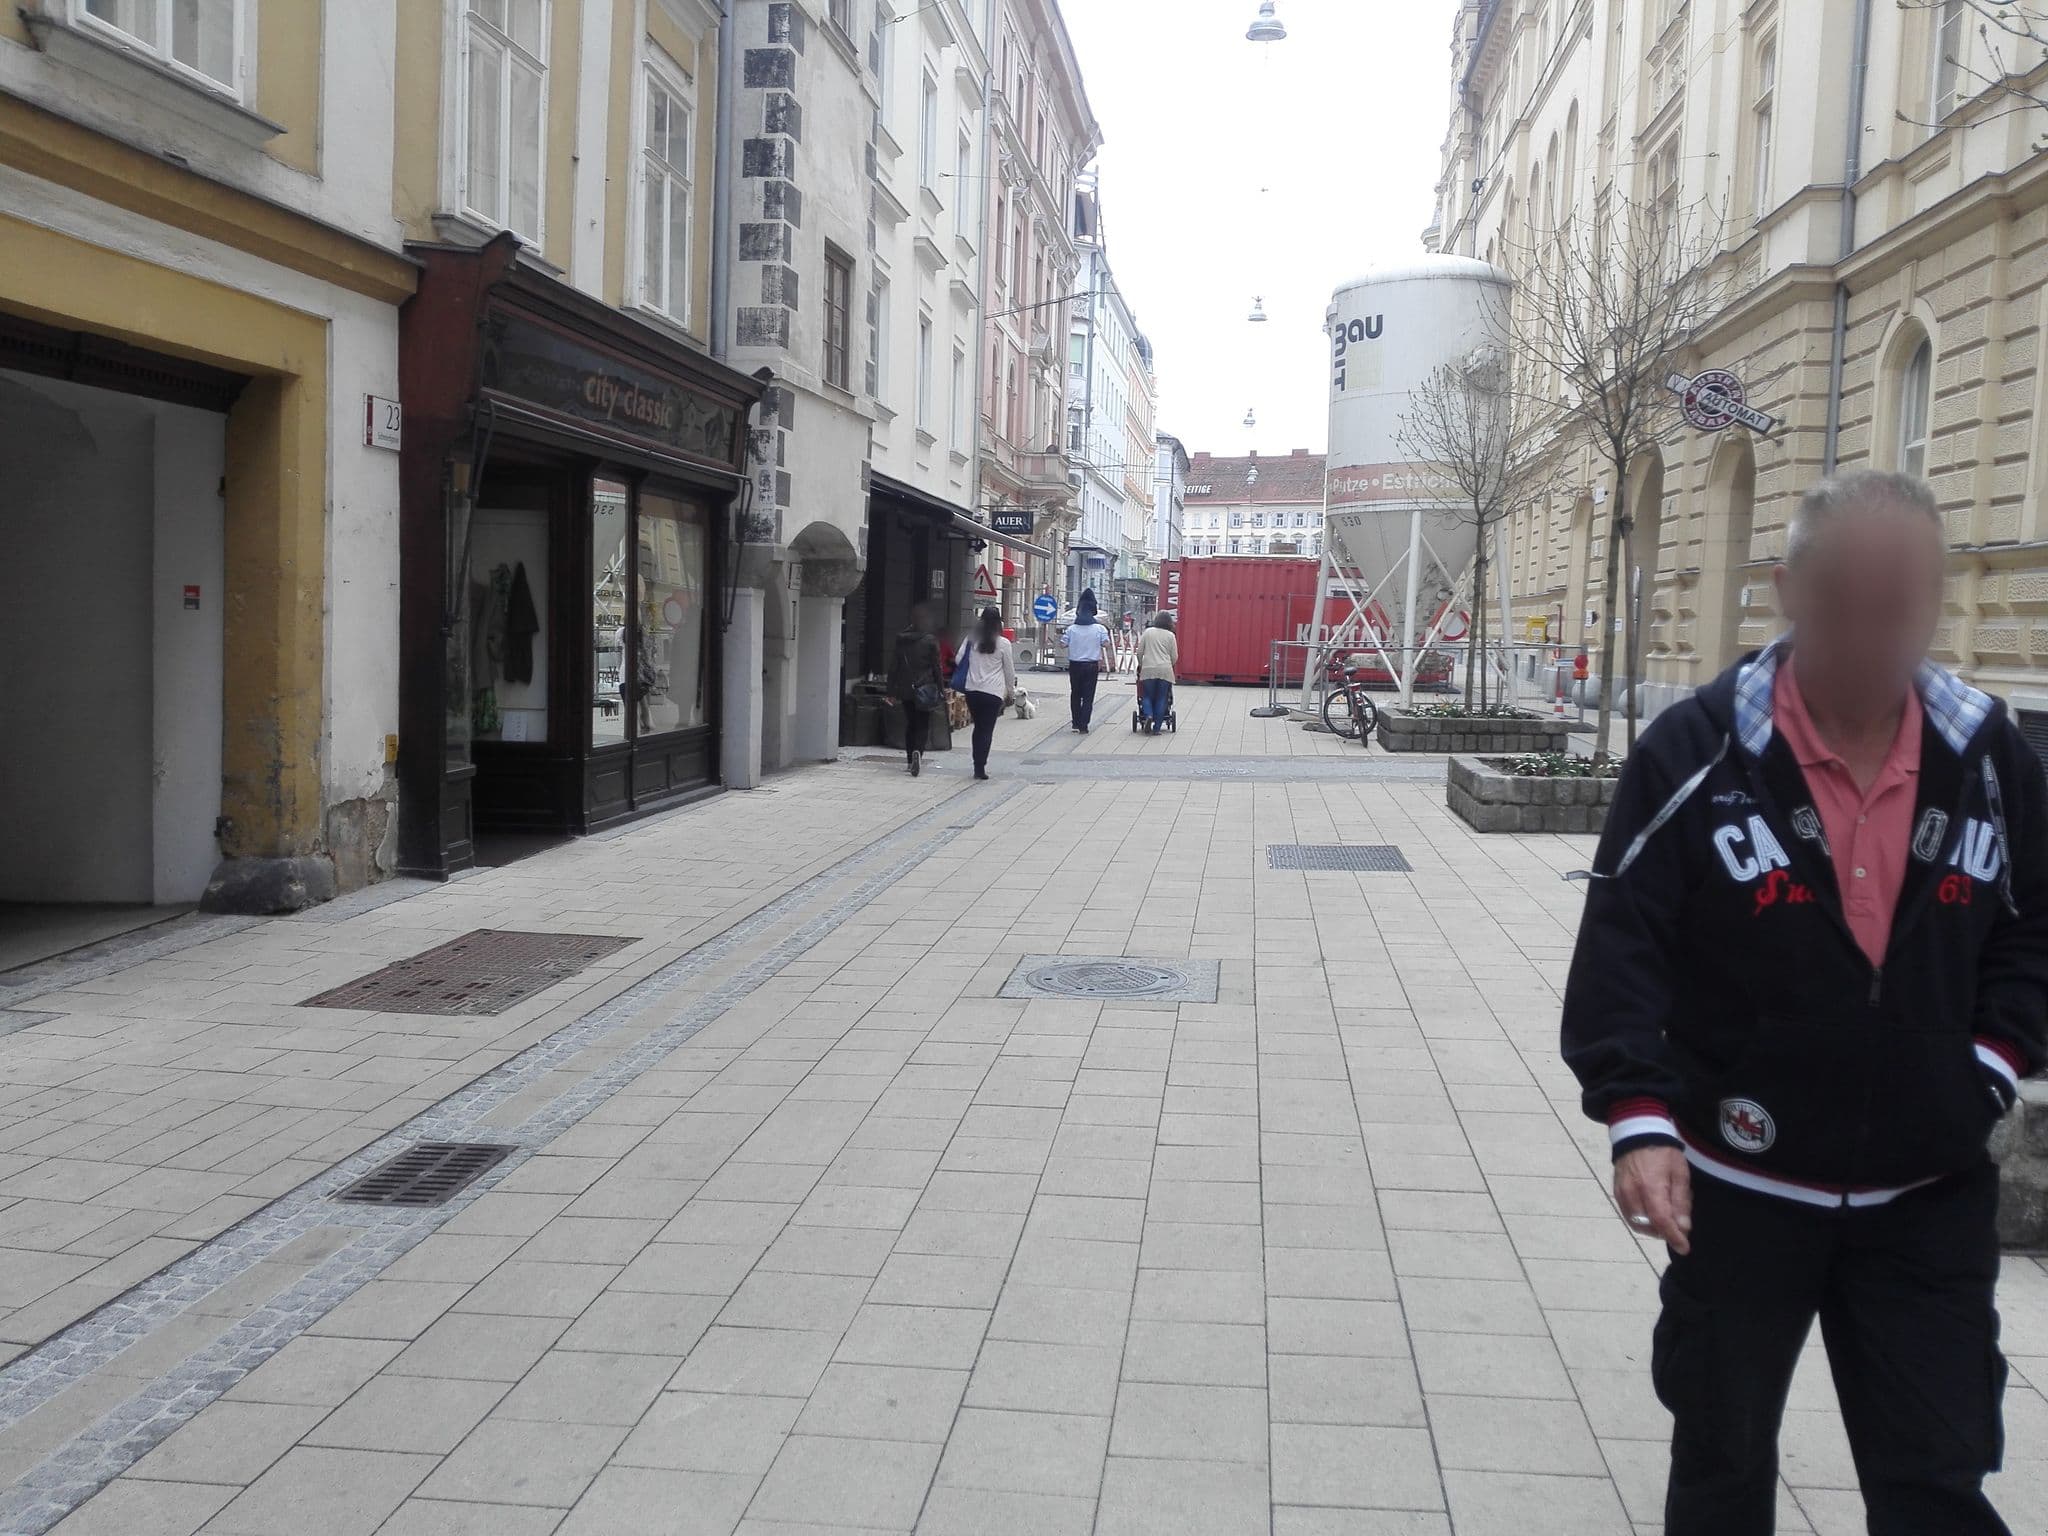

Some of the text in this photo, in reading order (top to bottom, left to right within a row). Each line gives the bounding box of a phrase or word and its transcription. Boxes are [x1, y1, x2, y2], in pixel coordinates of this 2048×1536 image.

[583, 368, 674, 430] city classic
[1702, 392, 1766, 426] AUTOMAT
[386, 404, 400, 431] 23
[995, 516, 1024, 526] AUER
